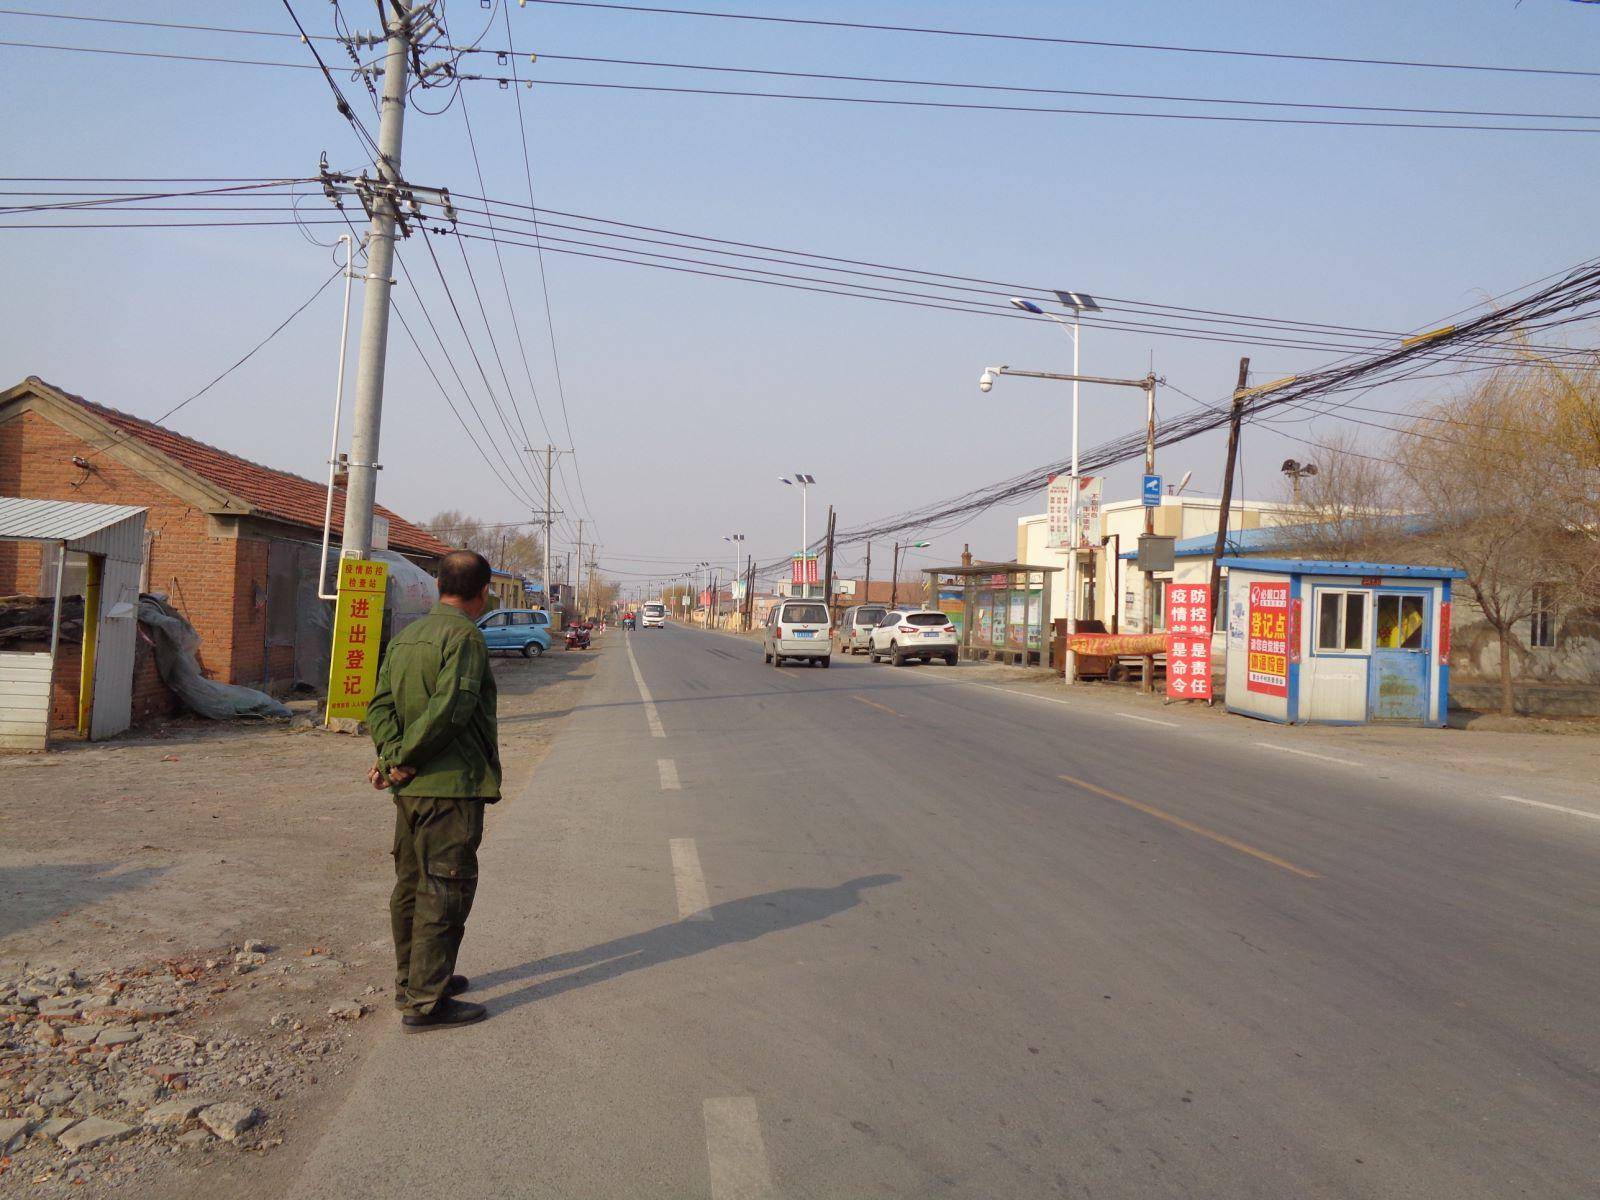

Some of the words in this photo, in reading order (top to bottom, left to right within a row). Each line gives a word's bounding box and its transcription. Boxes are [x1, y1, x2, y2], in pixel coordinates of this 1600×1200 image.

[345, 564, 383, 576] 疫情防控
[349, 578, 377, 589] 检查站
[1252, 612, 1286, 639] 登记点
[343, 598, 369, 695] 进出登记
